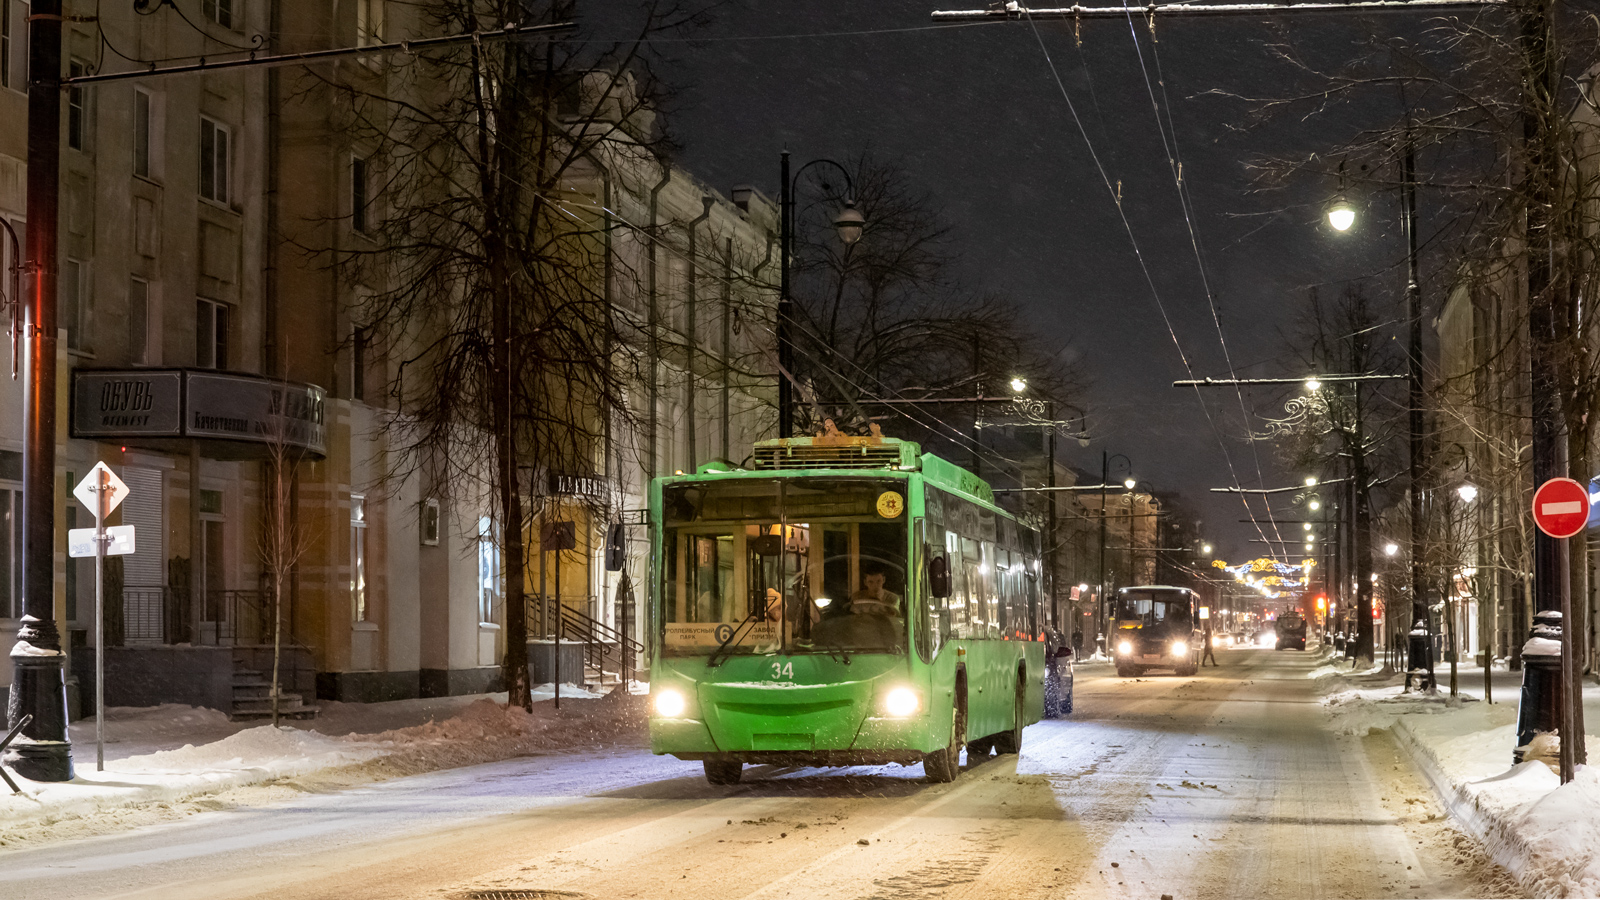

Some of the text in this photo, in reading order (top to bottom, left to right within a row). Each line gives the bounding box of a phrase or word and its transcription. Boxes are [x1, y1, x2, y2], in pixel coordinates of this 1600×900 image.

[101, 381, 153, 412] ОБУВЬ
[666, 626, 715, 634] РОЛЛЕЙБУСНЫЙ
[771, 661, 794, 679] 34
